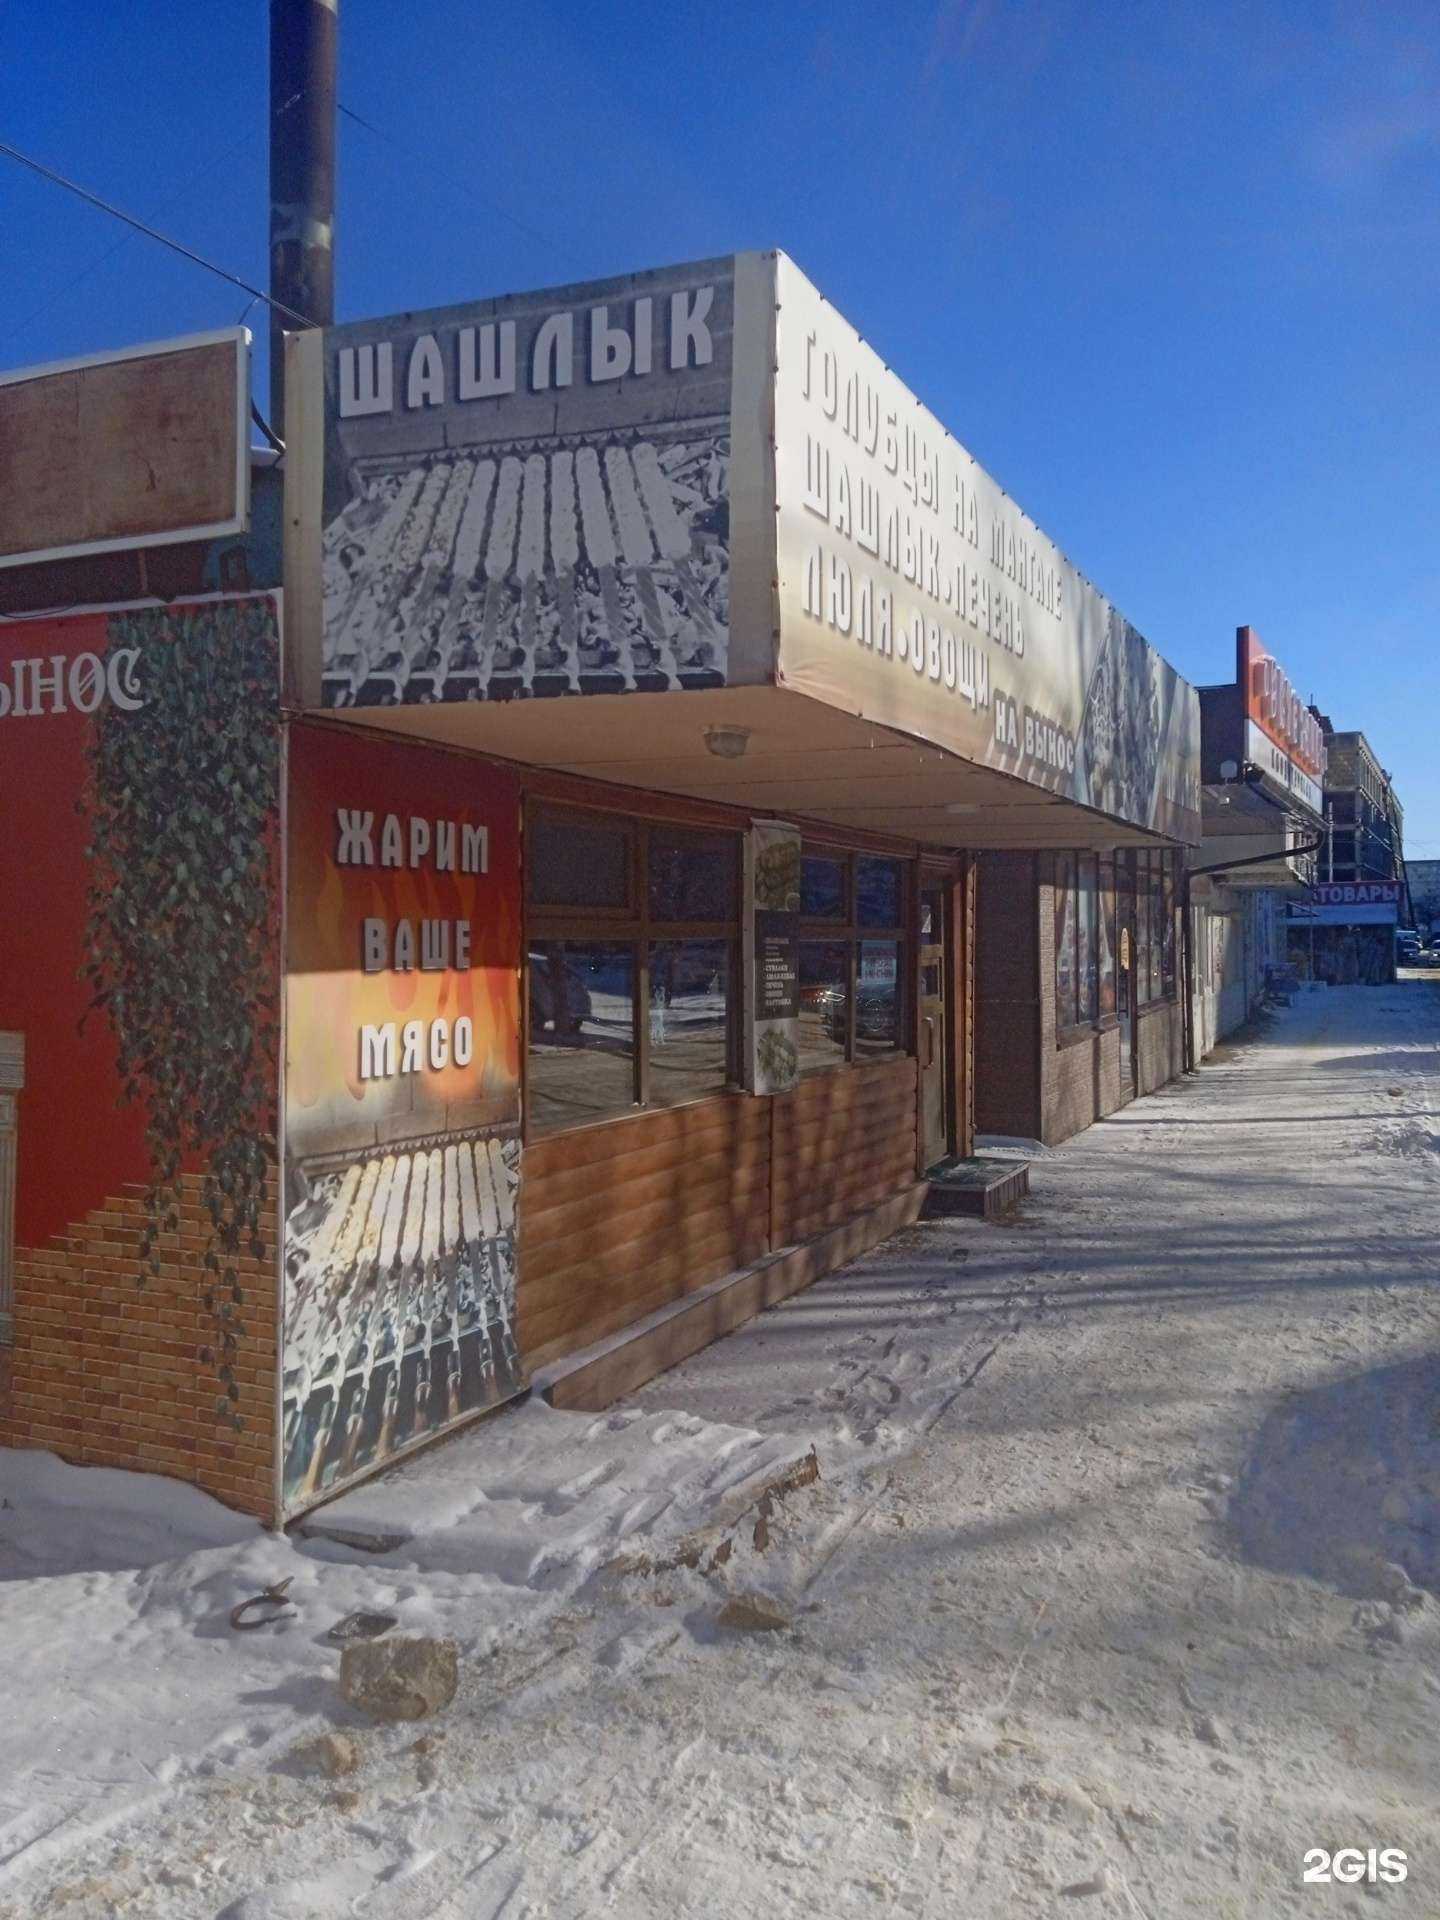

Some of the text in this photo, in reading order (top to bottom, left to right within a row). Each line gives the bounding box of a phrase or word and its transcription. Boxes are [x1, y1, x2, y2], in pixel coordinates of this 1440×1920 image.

[339, 286, 714, 418] ШАШЛЫК
[799, 328, 1063, 622] ГОЛУБЦЫ НА МАНГАЛЕ
[995, 699, 1075, 774] НА ВЫНОС
[337, 808, 490, 874] ЖАРИМ
[1318, 885, 1400, 904] ТОВАРЫ
[364, 917, 472, 973] ВАШЕ
[359, 1015, 475, 1080] МЯСО
